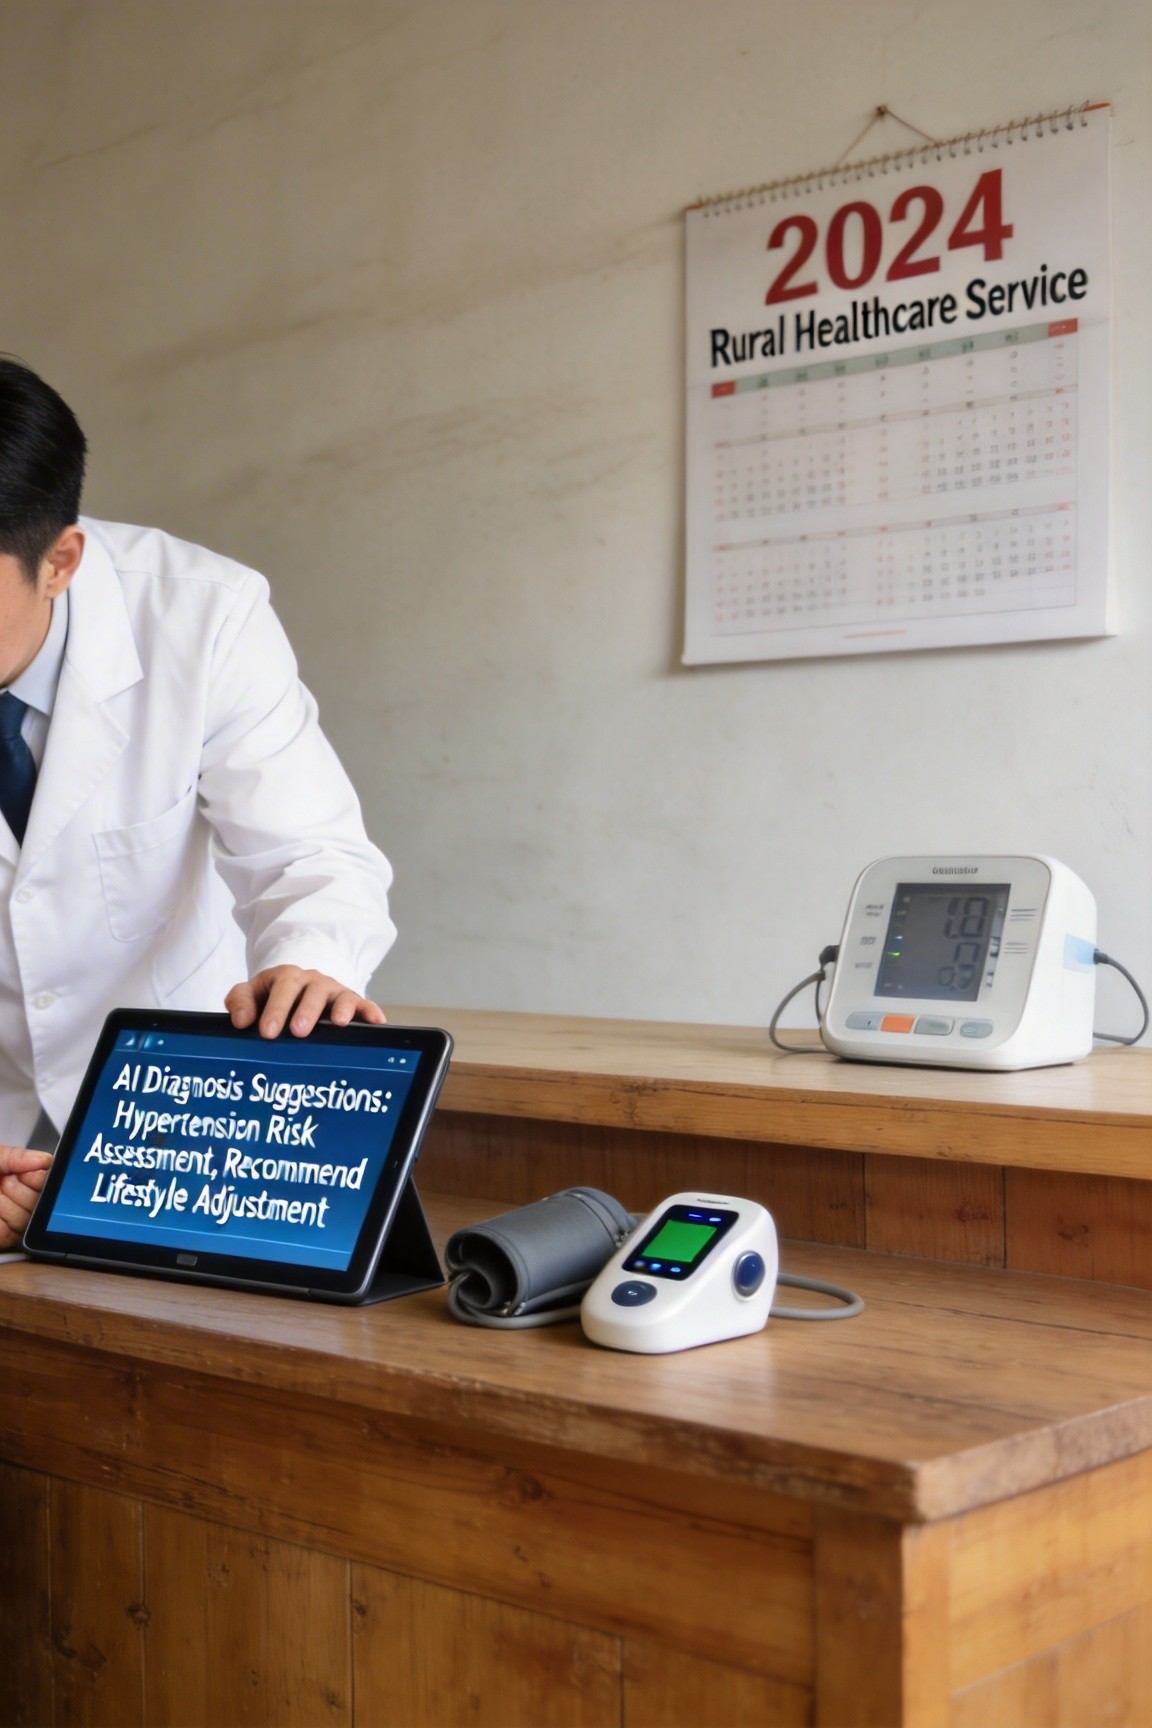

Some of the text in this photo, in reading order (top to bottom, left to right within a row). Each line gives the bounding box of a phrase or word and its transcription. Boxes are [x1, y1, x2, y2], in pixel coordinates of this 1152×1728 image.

[764, 168, 1014, 305] 2024
[710, 264, 1088, 368] Rural Healthcare Service
[112, 1065, 393, 1114] AI Diagnosis Suggestions:
[112, 1100, 318, 1149] Hypertension Risk
[84, 1132, 368, 1190] Assessment, Recommend
[90, 1172, 331, 1229] Lifestyle Adjustment
